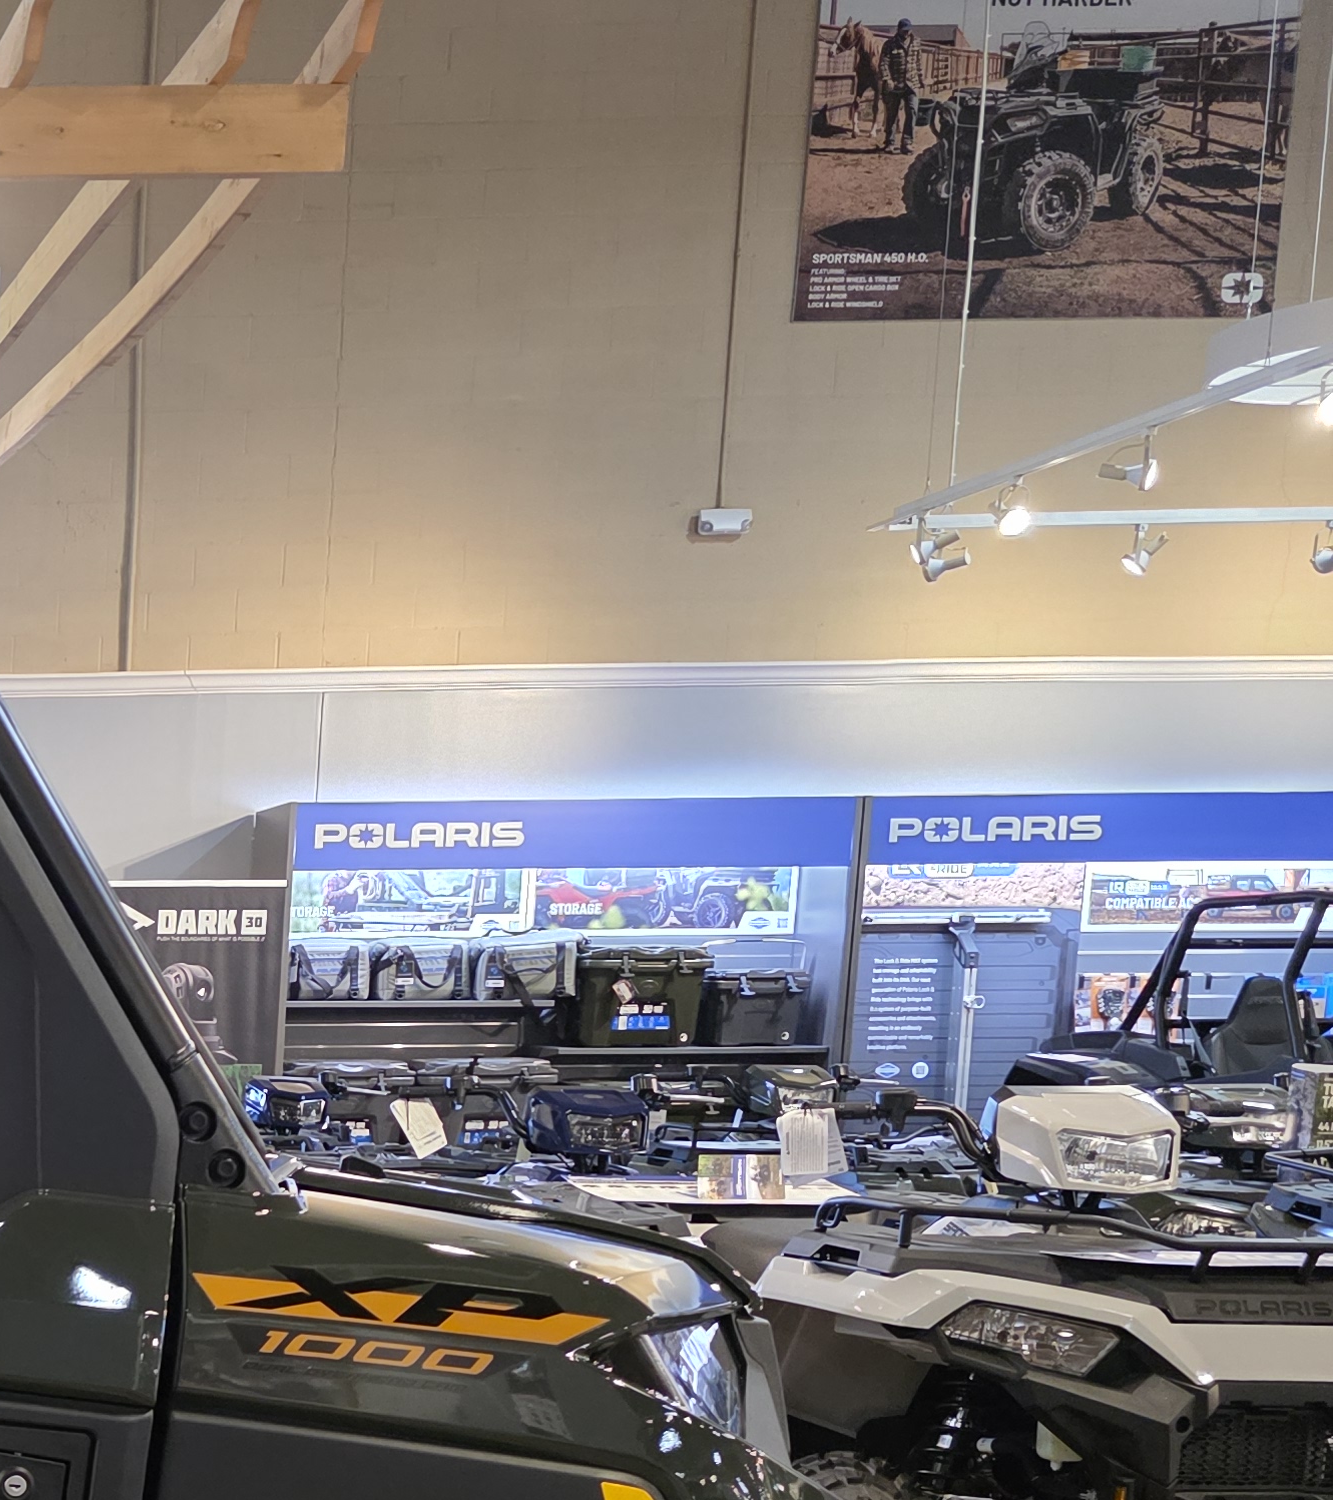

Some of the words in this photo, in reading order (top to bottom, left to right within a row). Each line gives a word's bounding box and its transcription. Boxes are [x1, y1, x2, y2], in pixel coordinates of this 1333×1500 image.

[812, 253, 882, 264] SPORTSMAN
[884, 253, 905, 263] 450
[907, 252, 929, 263] H.O.
[314, 820, 526, 850] POLARIS
[888, 814, 1104, 844] POLARIS
[1109, 881, 1125, 894] LR
[290, 905, 334, 918] TORAGE
[550, 902, 602, 916] STORAGE
[1105, 897, 1177, 910] COMPATIBLE
[157, 909, 237, 935] DARK
[245, 916, 263, 928] 30
[225, 1264, 567, 1327] XP
[1194, 1299, 1333, 1317] POLARIS
[258, 1330, 494, 1376] 1000
